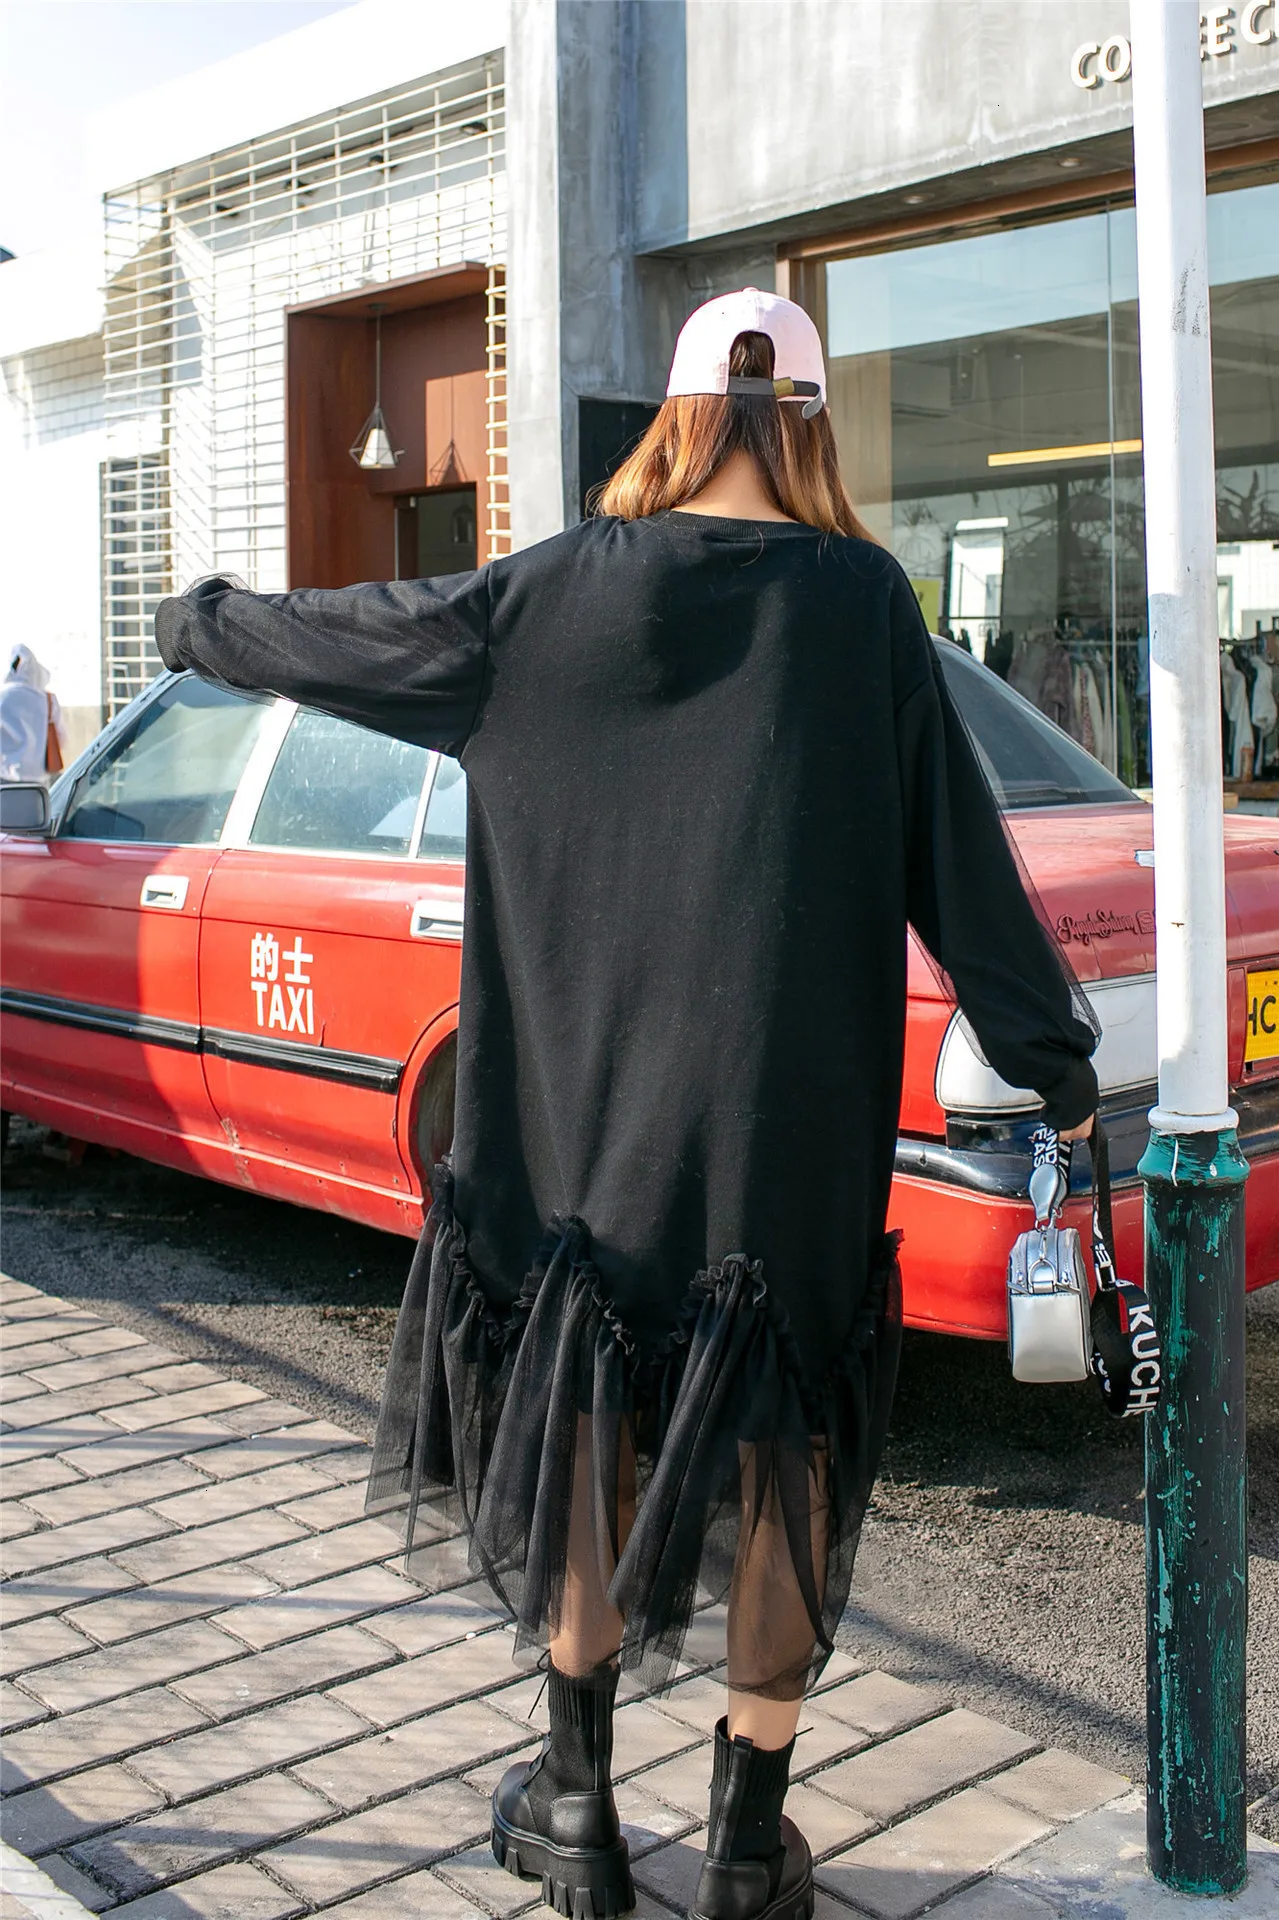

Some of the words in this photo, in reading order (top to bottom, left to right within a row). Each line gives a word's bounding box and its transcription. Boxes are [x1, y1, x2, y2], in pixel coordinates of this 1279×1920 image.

[1071, 6, 1234, 89] COE
[1241, 0, 1279, 44] C
[250, 931, 314, 985] 的士
[250, 980, 315, 1035] TAXI
[1121, 1303, 1161, 1417] KUCH
